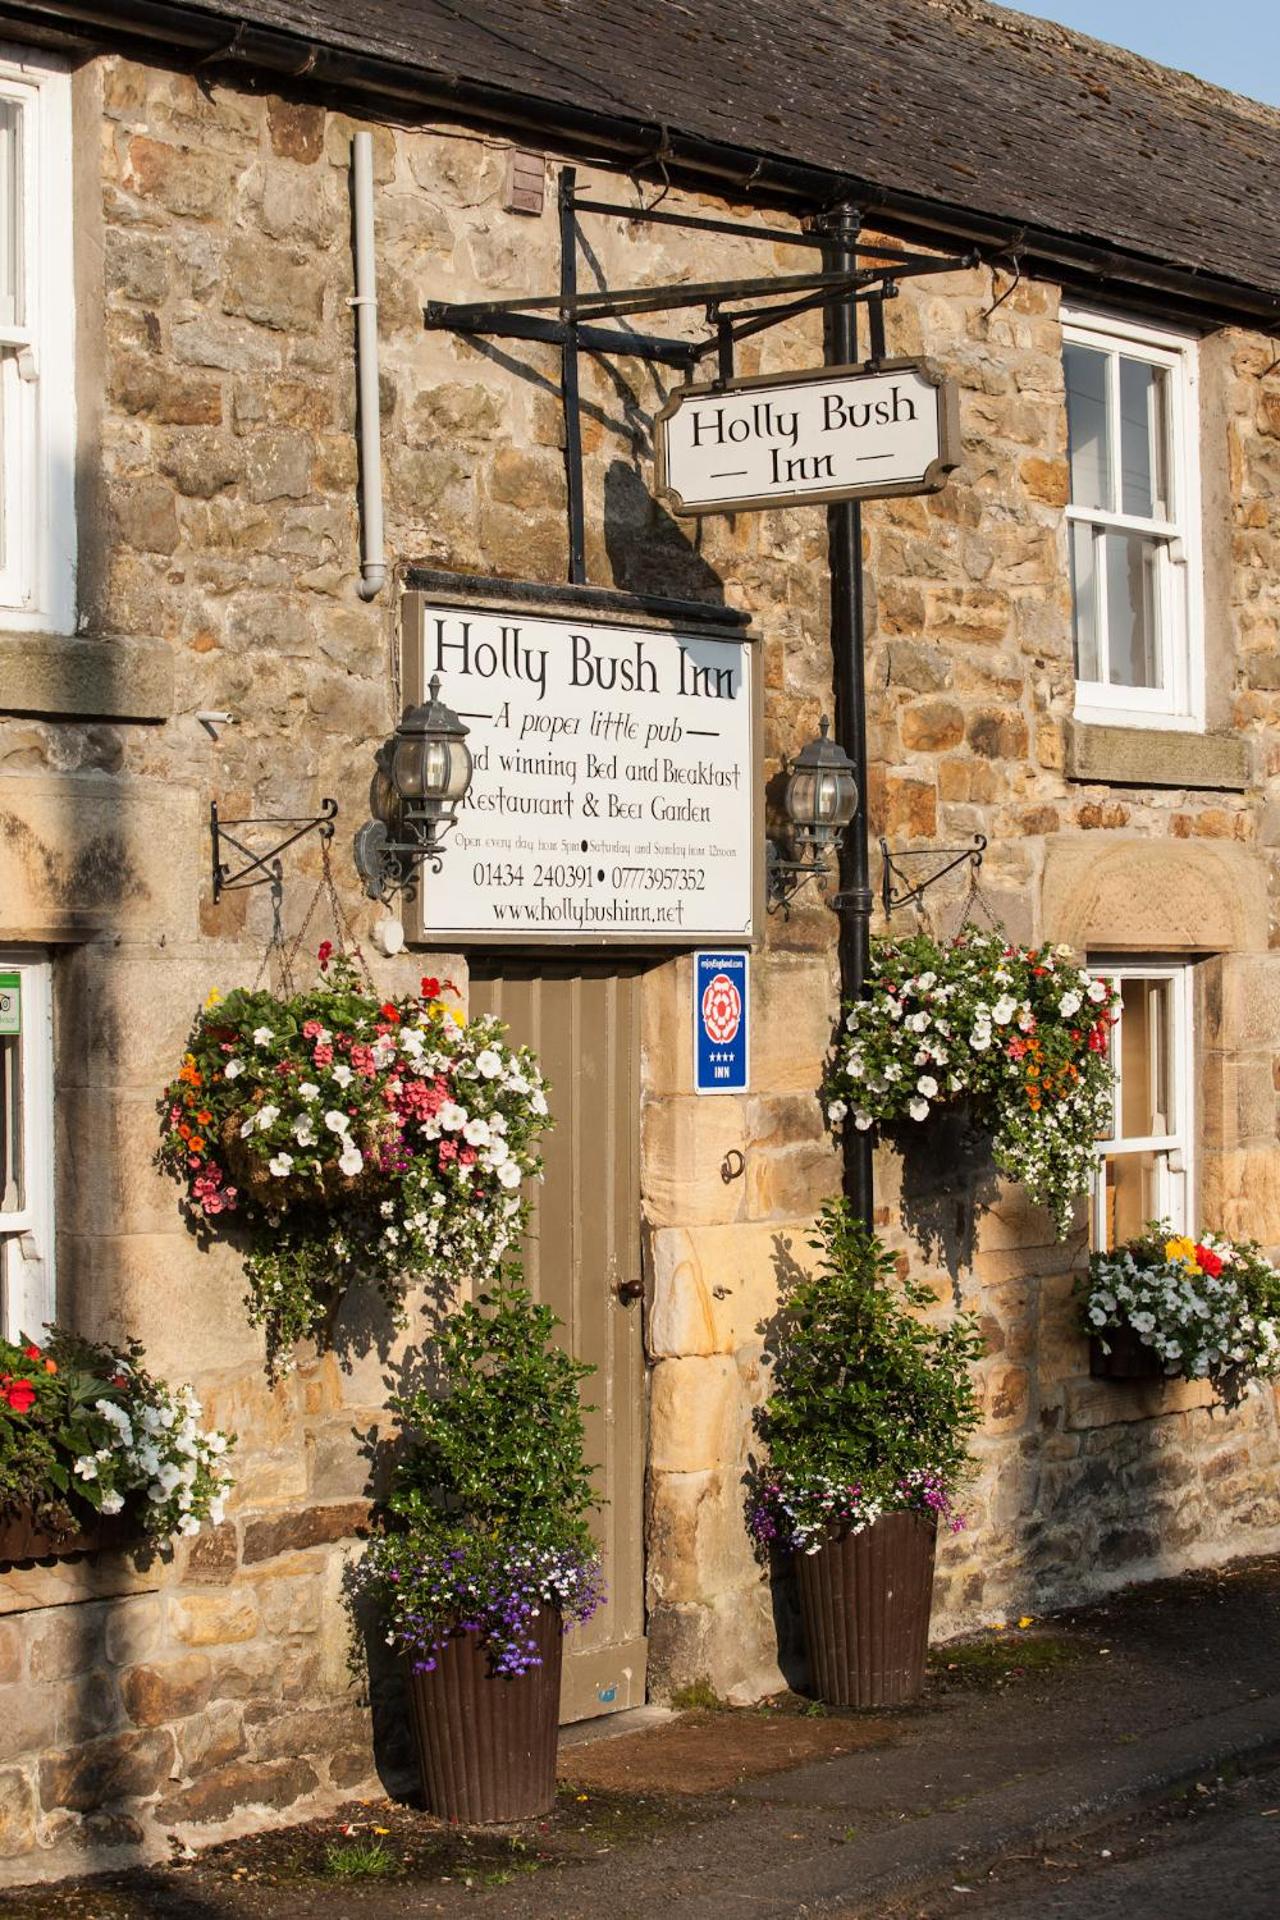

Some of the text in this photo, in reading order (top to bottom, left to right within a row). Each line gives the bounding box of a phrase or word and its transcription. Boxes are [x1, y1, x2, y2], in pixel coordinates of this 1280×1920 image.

[690, 387, 920, 448] Holly Bush
[768, 447, 837, 485] Inn
[432, 618, 736, 701] Holly Bush Inn
[494, 702, 683, 749] A proper little pub
[499, 748, 577, 785] winning
[586, 753, 617, 779] Bed
[625, 758, 658, 782] and
[663, 758, 741, 791] Breakfast
[462, 785, 711, 822] Restaurant & Beer Garden
[515, 834, 534, 854] day
[473, 862, 705, 890] 01434 240391 07773957352
[493, 897, 684, 928] www.hollybushinn.net
[714, 1066, 730, 1078] INN
